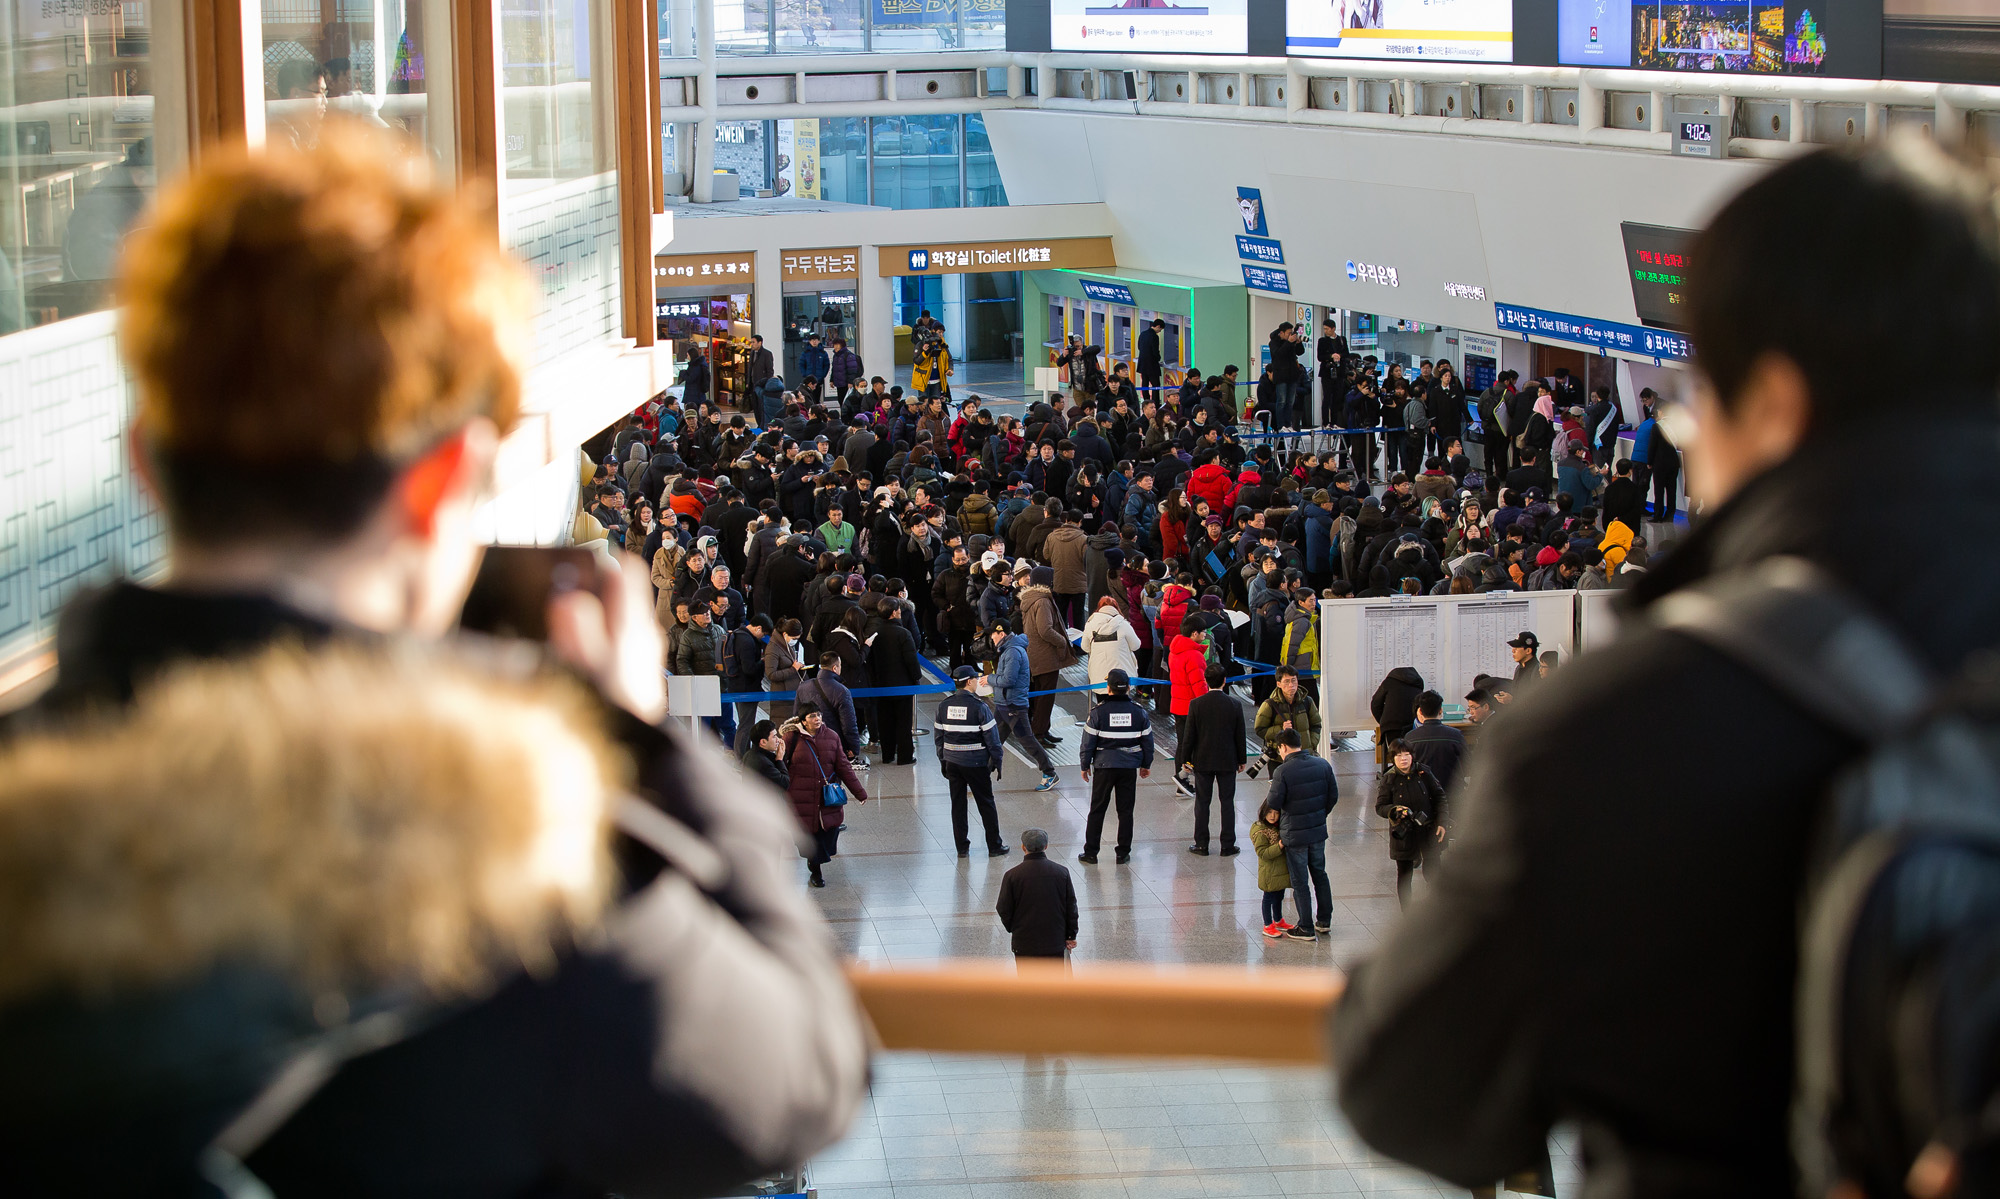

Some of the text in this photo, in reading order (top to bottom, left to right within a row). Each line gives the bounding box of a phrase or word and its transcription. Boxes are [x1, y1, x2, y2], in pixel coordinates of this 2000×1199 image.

[931, 247, 1051, 267] 화장실 Toilet 化粧室
[701, 262, 750, 275] 호두과자
[1358, 262, 1400, 288] 우리은행
[1506, 309, 1529, 329] 표사는
[1529, 313, 1537, 330] 곳
[1655, 335, 1679, 355] 표사는
[1680, 340, 1688, 358] 곳
